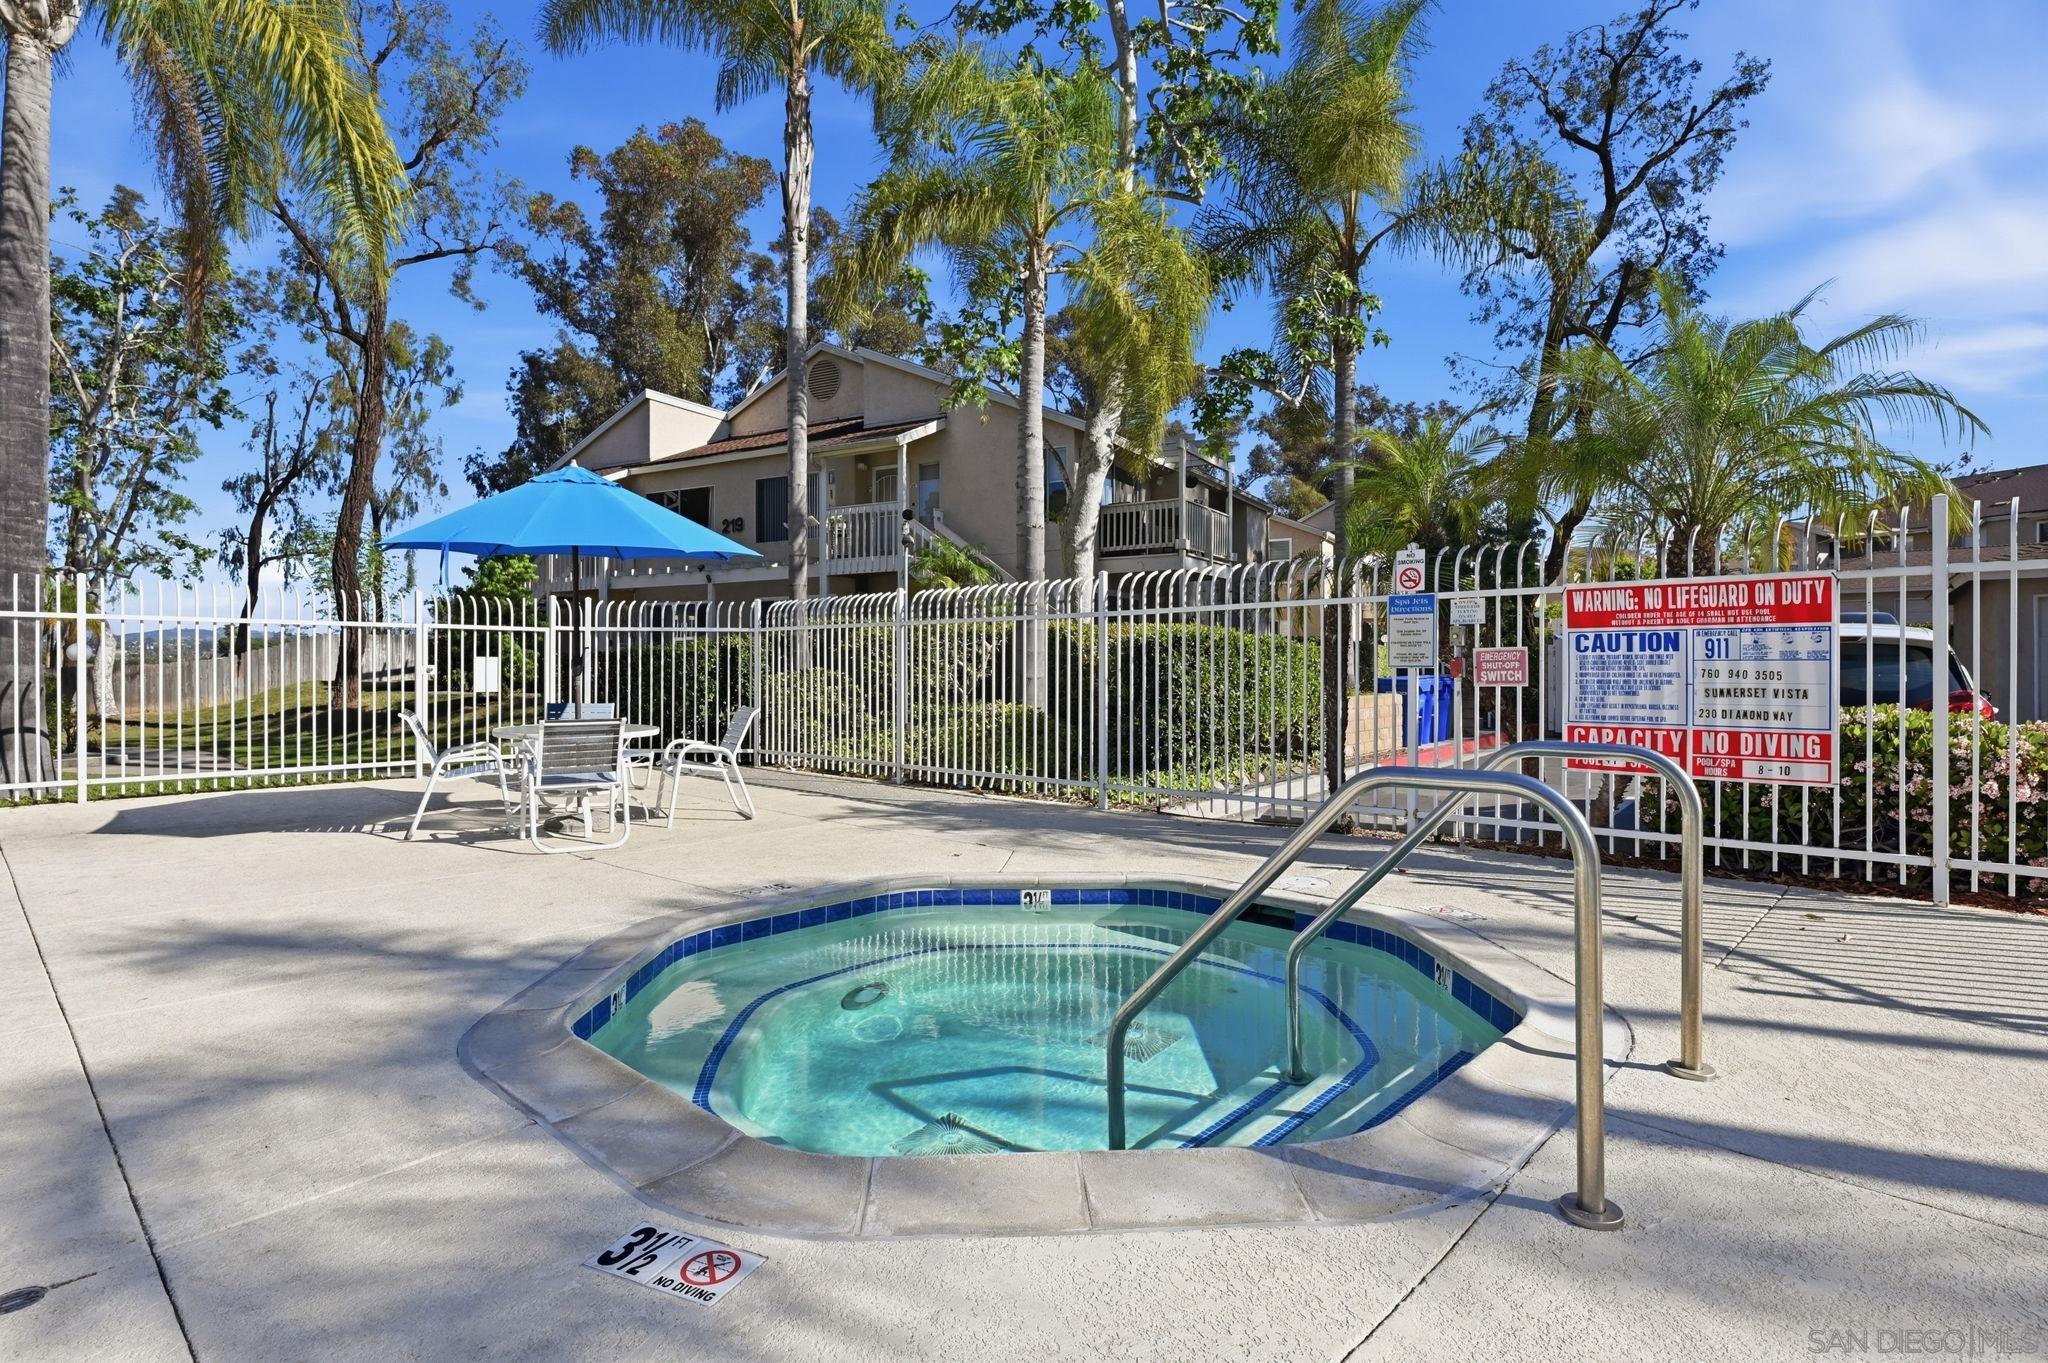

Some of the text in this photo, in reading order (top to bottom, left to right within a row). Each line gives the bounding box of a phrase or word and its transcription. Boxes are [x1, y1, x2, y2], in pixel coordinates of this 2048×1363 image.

[722, 517, 744, 534] 219
[1572, 579, 1825, 612] WARNING: NO LIFEGUARD ON DUTY
[1394, 598, 1410, 606] Spa
[1391, 605, 1433, 613] Directions
[1575, 632, 1679, 653] CAUTION
[1705, 638, 1729, 659] 911
[1480, 651, 1521, 660] EMERGENCY
[1481, 661, 1520, 670] SHUT-OFF
[1480, 670, 1523, 682] SWITCH
[1701, 669, 1783, 681] 760 940 3505
[1704, 688, 1809, 700] SUMMERSET VISTA
[1698, 708, 1793, 722] 230 DIAMOND WAY
[1574, 728, 1683, 752] CAPACITY
[1702, 731, 1821, 758] NO DIVING
[1696, 757, 1736, 768] POOL/SPA
[1704, 767, 1728, 777] HOURS
[1758, 765, 1764, 775] 8
[1779, 766, 1791, 776] 10
[671, 1236, 693, 1249] FT
[653, 1275, 717, 1302] NO DIVING
